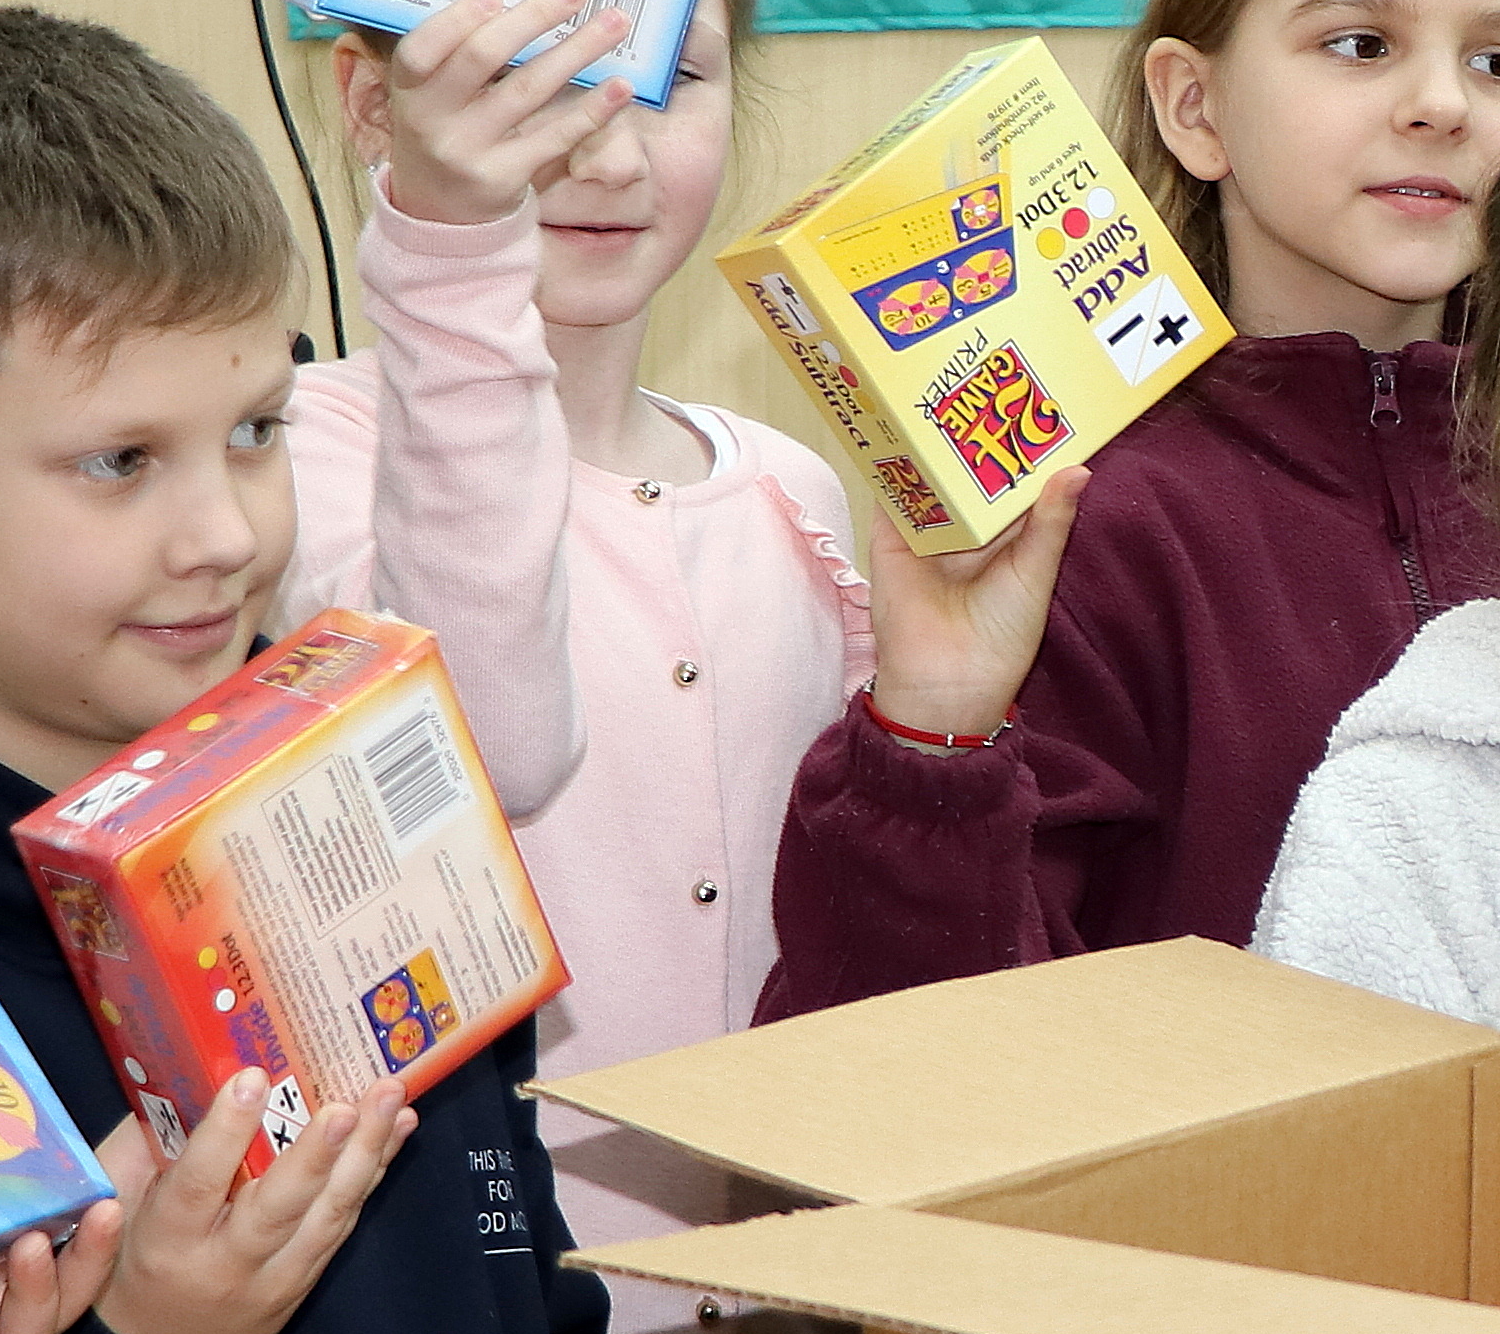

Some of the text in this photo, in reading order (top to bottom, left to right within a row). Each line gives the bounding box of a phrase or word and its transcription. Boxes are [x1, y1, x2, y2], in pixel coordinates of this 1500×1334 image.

[974, 97, 1034, 150] combinations
[1017, 74, 1041, 98] Item
[999, 106, 1045, 148] self-check
[1024, 137, 1084, 188] Ages 6 and up
[1052, 214, 1141, 291] Subtract
[1072, 243, 1154, 324] Add
[744, 278, 873, 452] Add/Subtract
[913, 327, 990, 419] PRIMER
[950, 347, 1019, 445] GAME
[969, 365, 1062, 487] 24
[248, 999, 291, 1074] Divide
[468, 1150, 497, 1172] THIS
